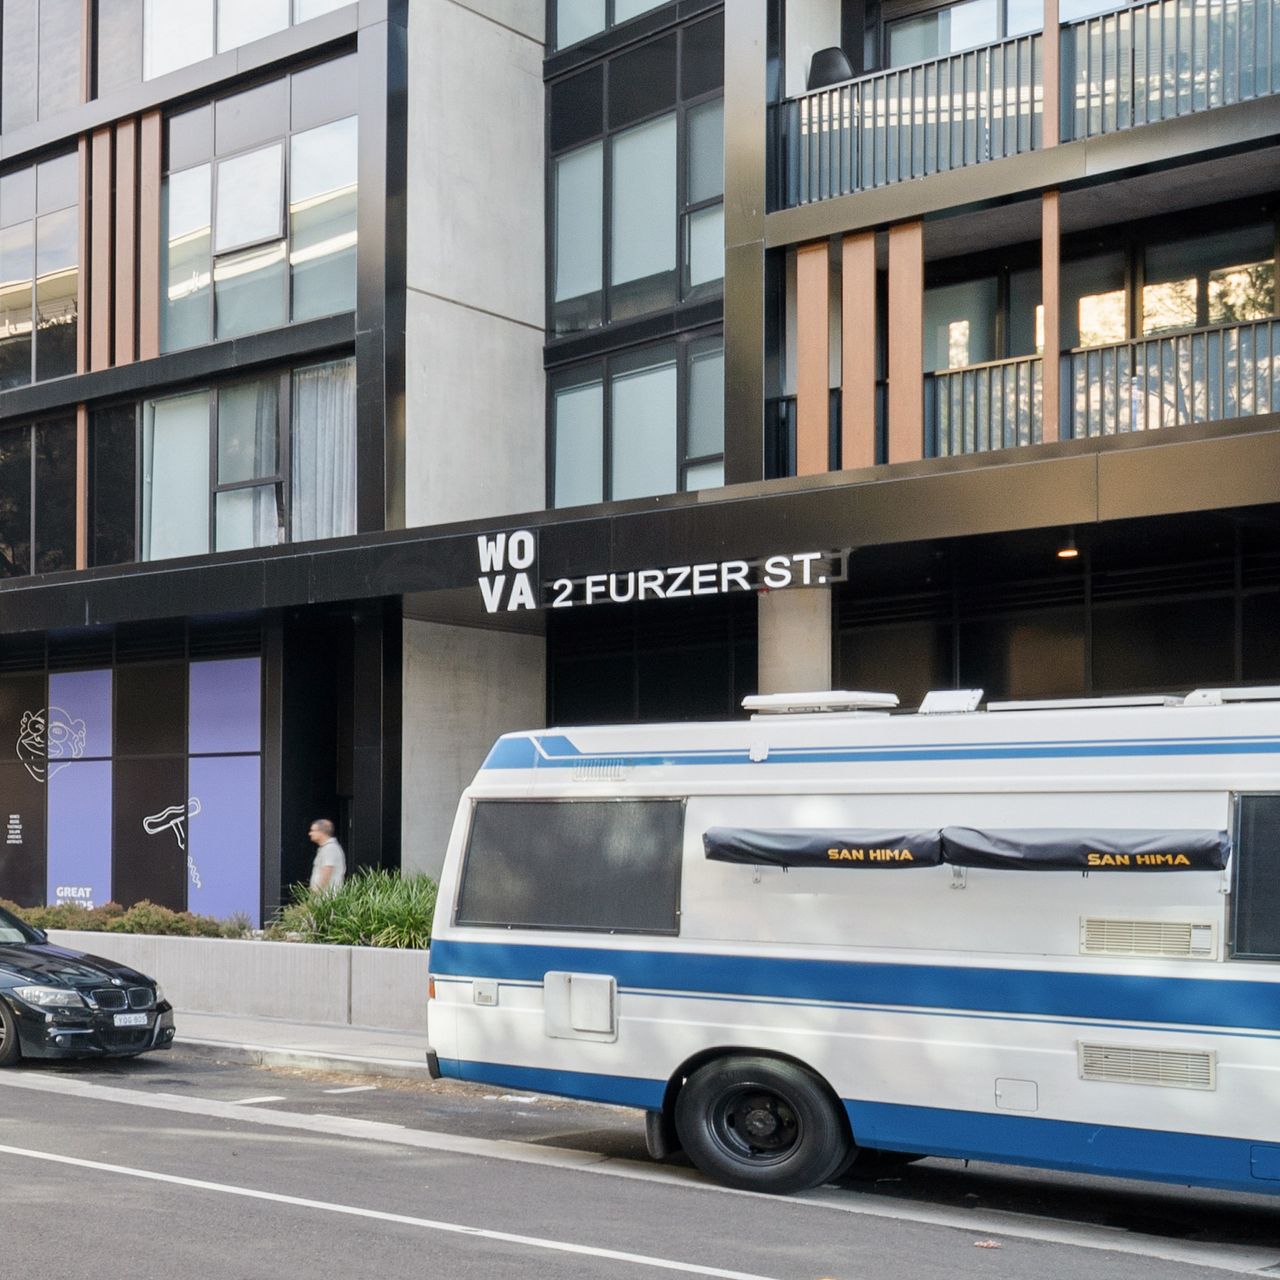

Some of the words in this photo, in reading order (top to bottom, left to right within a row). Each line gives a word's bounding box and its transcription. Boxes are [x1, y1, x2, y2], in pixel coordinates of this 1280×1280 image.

[477, 530, 535, 572] WO
[477, 572, 536, 613] VA
[552, 578, 573, 608] 2
[586, 560, 751, 605] FURZER
[763, 552, 826, 589] ST.
[827, 848, 864, 860] SAN
[869, 848, 914, 861] HIMA
[1087, 853, 1130, 866] SAN
[1135, 853, 1191, 866] HIMA
[55, 886, 92, 898] GREAT
